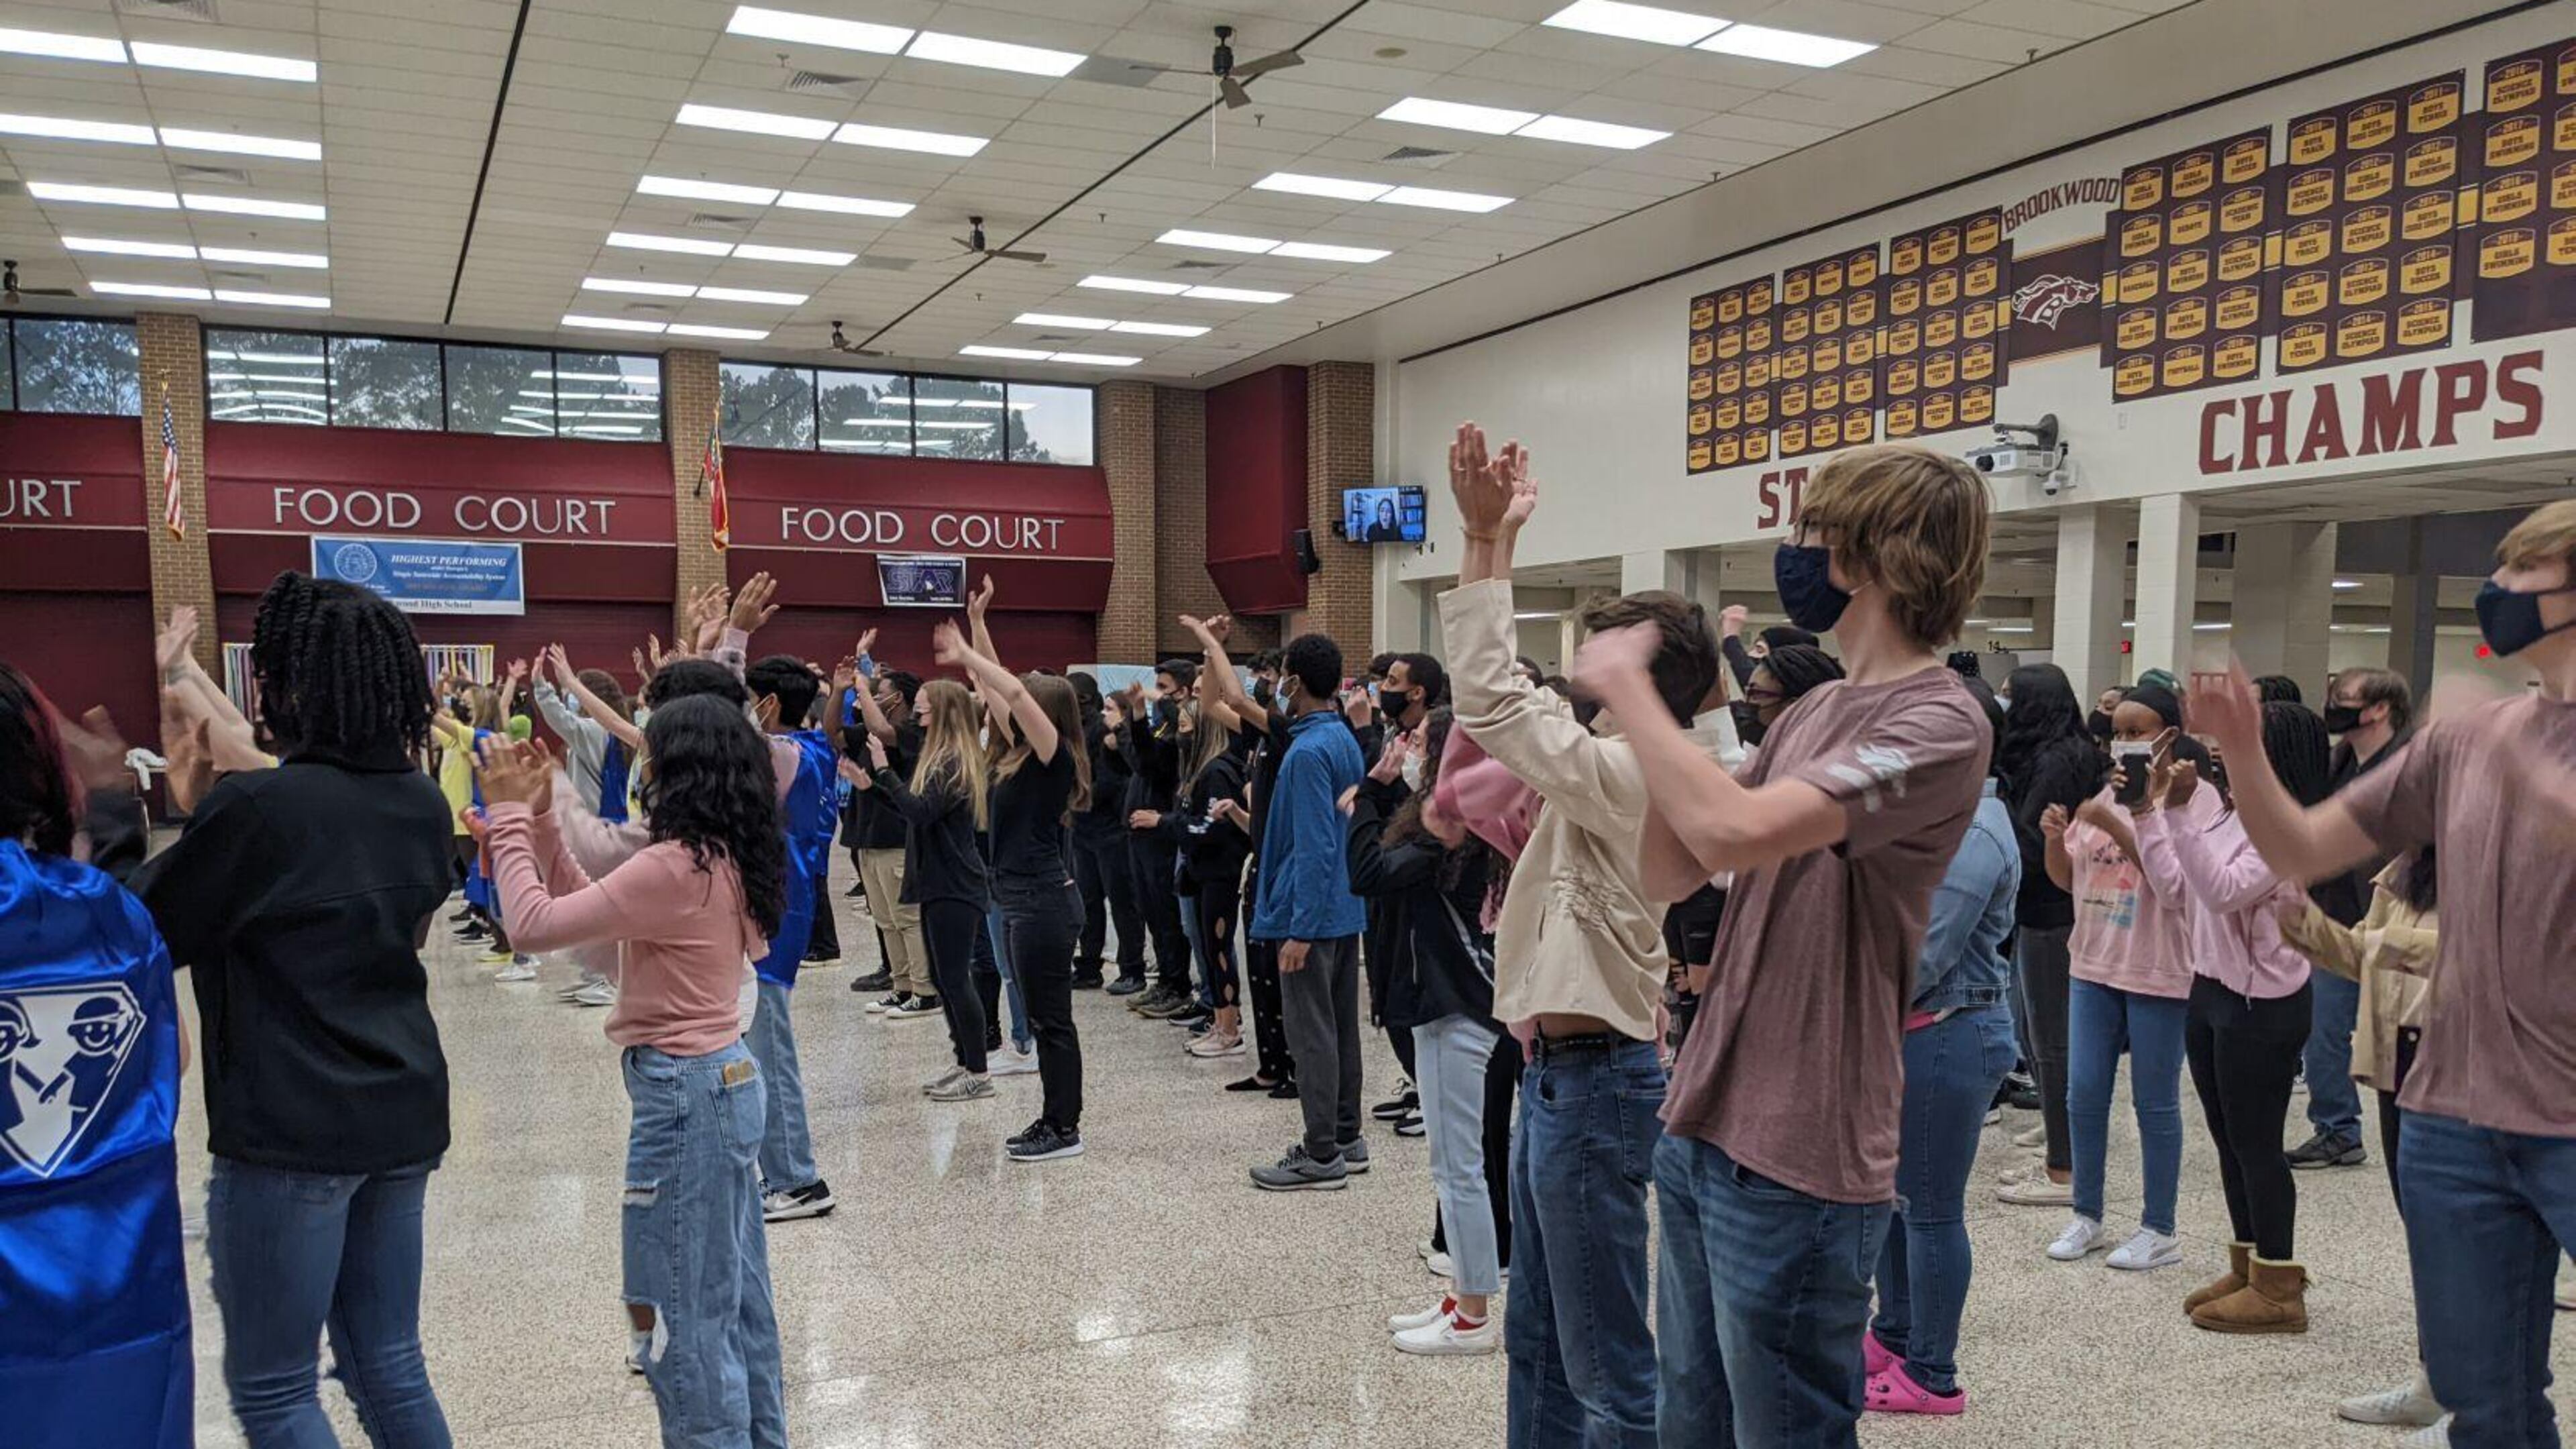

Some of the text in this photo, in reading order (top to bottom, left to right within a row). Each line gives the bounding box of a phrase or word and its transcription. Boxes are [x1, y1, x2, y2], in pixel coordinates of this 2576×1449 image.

[2003, 178, 2120, 233] BROOKWOOD
[2198, 350, 2544, 475] CHAMPS
[274, 488, 616, 535] FOOD COURT
[782, 507, 1065, 550] FOOD COURT
[391, 555, 508, 567] HIGHEST PERFORMING
